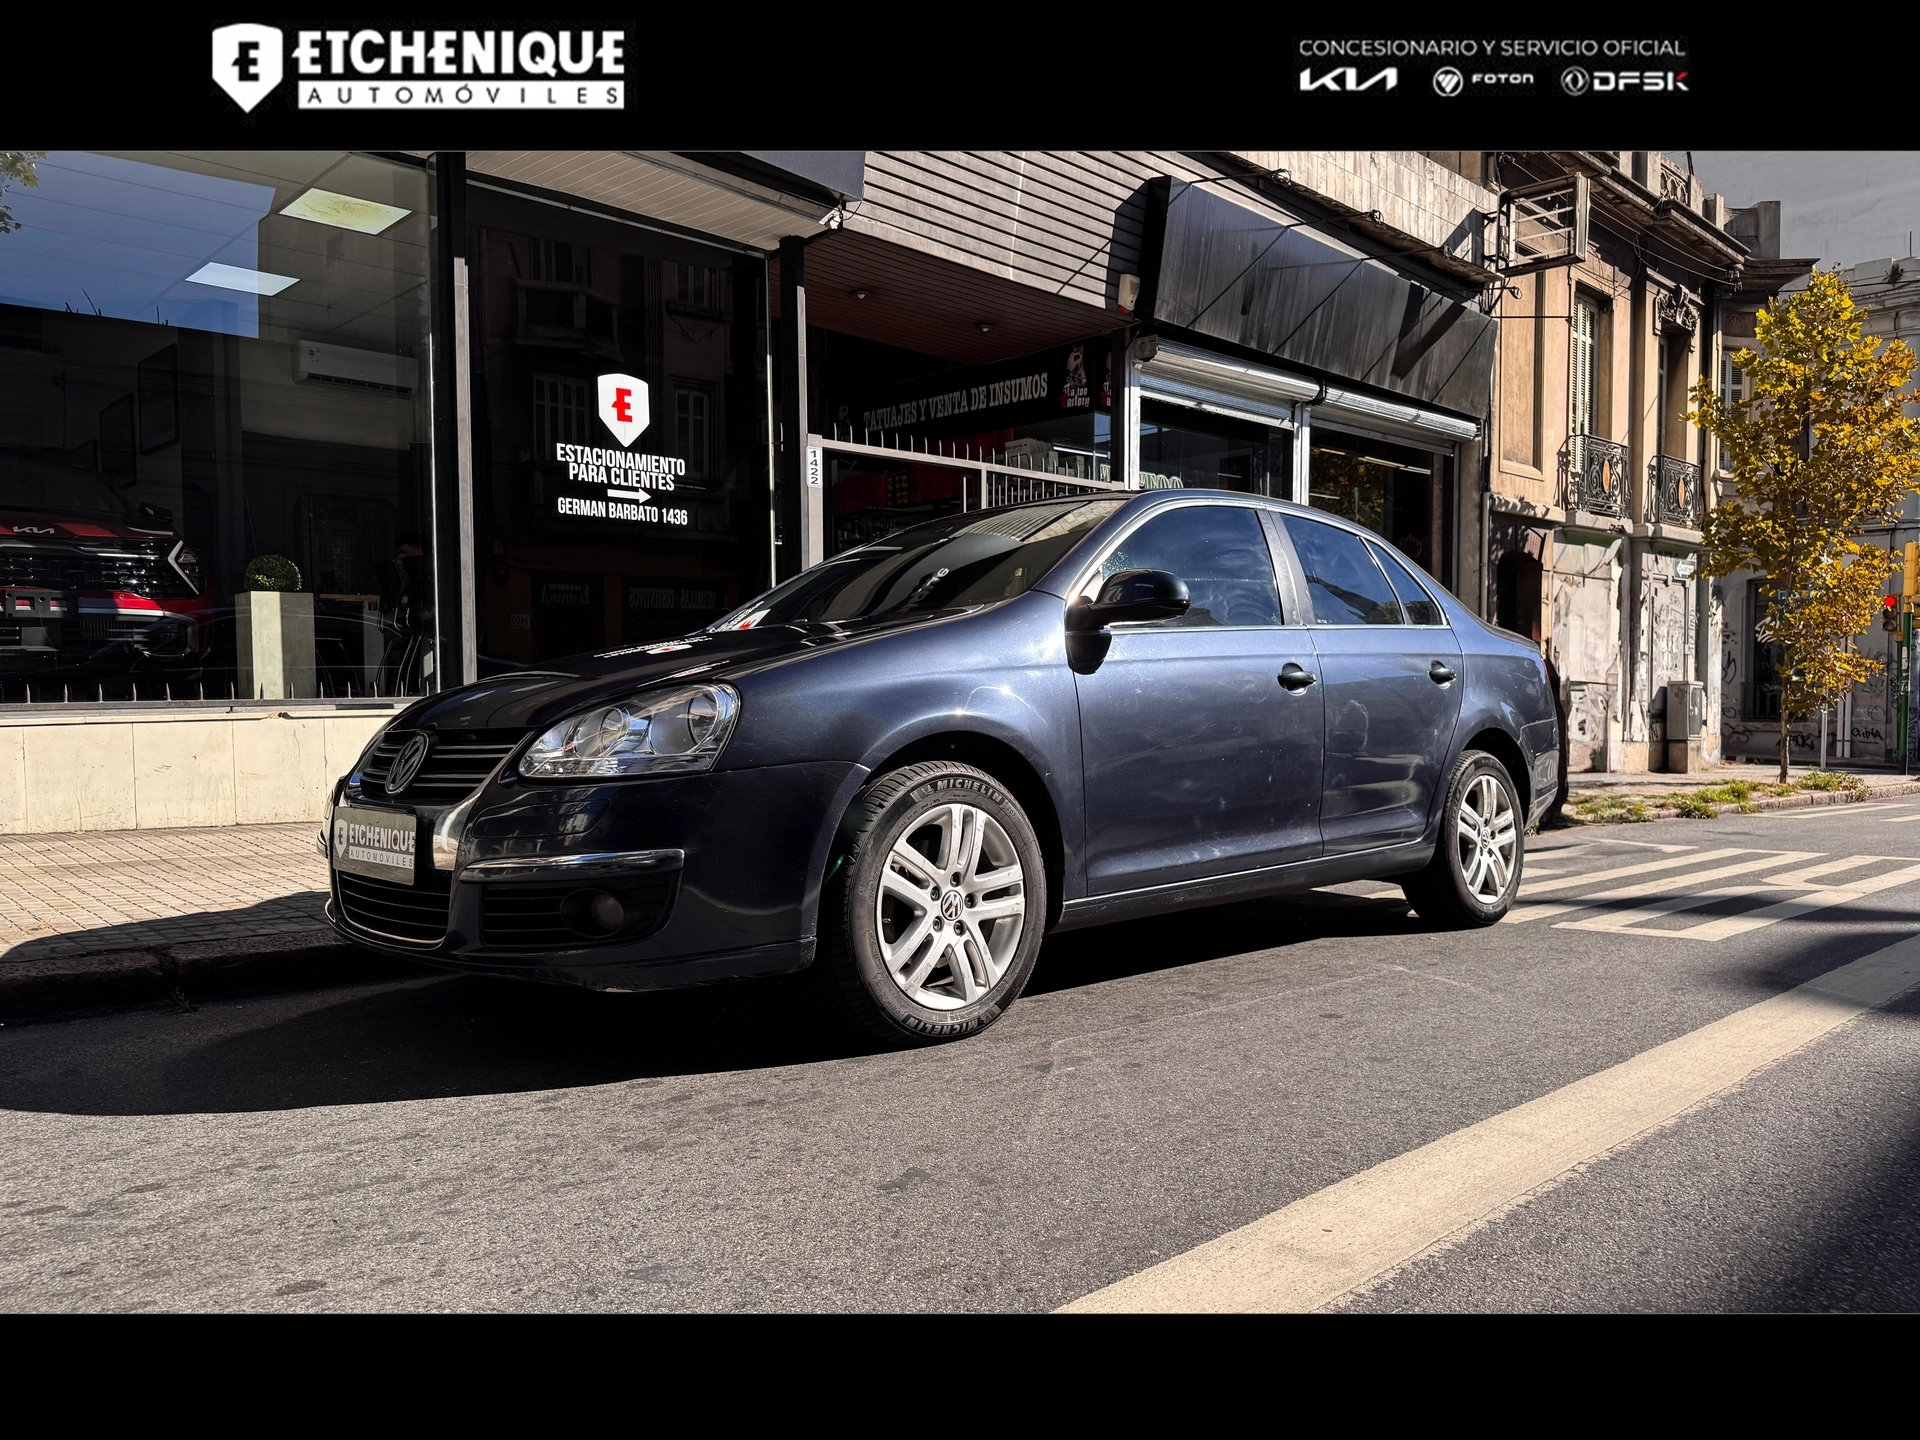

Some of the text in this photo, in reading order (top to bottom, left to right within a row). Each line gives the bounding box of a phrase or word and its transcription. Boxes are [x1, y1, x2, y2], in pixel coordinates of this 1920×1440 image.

[863, 372, 1048, 432] TATUAJES Y VENTA DE INSUMOS
[556, 442, 686, 476] ESTACIONAMIENTO
[809, 449, 820, 486] 1422
[569, 462, 675, 491] PARA CLIENTES
[557, 496, 688, 526] GERMAN BARBATO 1436
[937, 778, 1002, 804] MICHELIN
[349, 823, 415, 853] ETCHENIQUE
[350, 848, 413, 867] AUTOMÓVILES
[905, 1018, 979, 1035] MICHELIN
